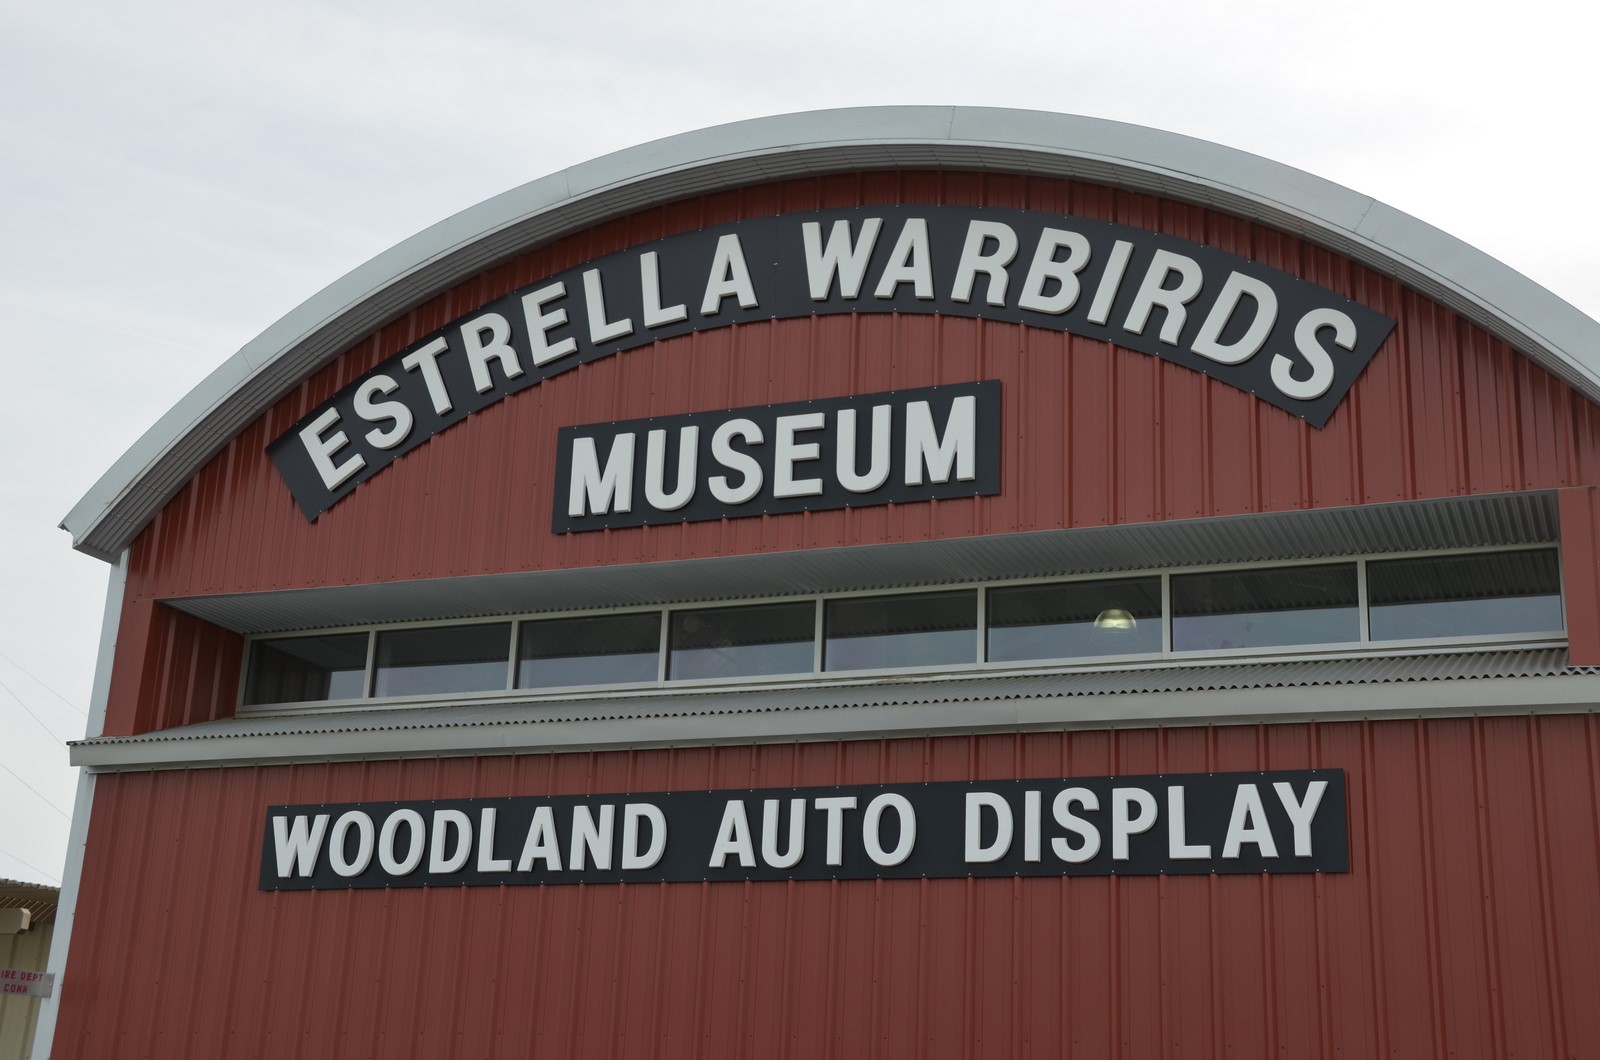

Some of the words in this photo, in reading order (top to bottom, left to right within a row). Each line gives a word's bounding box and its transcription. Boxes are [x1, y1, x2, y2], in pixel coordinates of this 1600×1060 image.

[299, 233, 757, 491] ESTRELLA
[802, 217, 1357, 399] WARBIRDS
[568, 395, 976, 517] MUSEUM
[272, 803, 666, 878] WOODLAND
[708, 793, 917, 868] AUTO
[964, 780, 1328, 866] DISPLAY
[0, 969, 17, 979] IRE
[20, 971, 43, 982] DEPT
[3, 984, 28, 993] CONN
